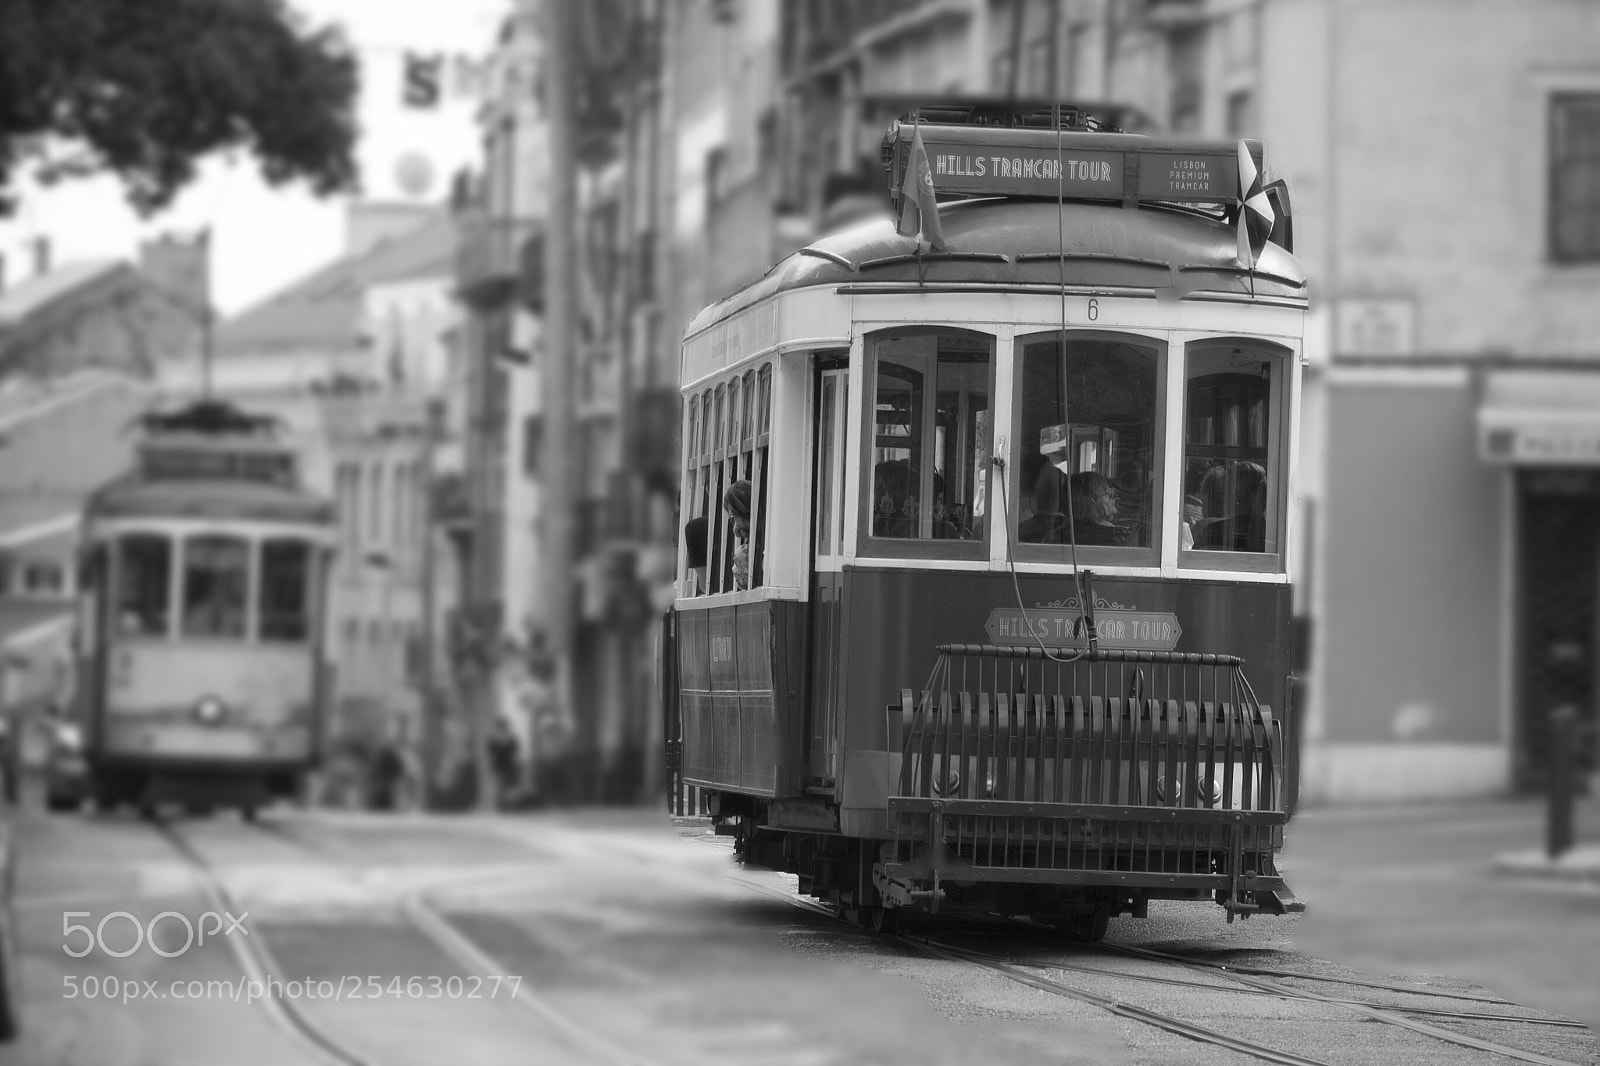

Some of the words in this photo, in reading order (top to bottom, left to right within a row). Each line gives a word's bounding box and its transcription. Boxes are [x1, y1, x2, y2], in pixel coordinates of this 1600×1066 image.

[936, 154, 986, 177] HILLS
[990, 157, 1064, 180] TRAMCAR
[1067, 160, 1112, 182] TOUR
[1173, 160, 1206, 170] LISBON
[1169, 171, 1210, 180] PREMIUM
[1170, 181, 1209, 191] TRAMCAR
[1088, 298, 1099, 321] 6
[999, 616, 1049, 638] HILLS
[1054, 618, 1126, 640] TRACAR
[1130, 620, 1172, 641] TOUR
